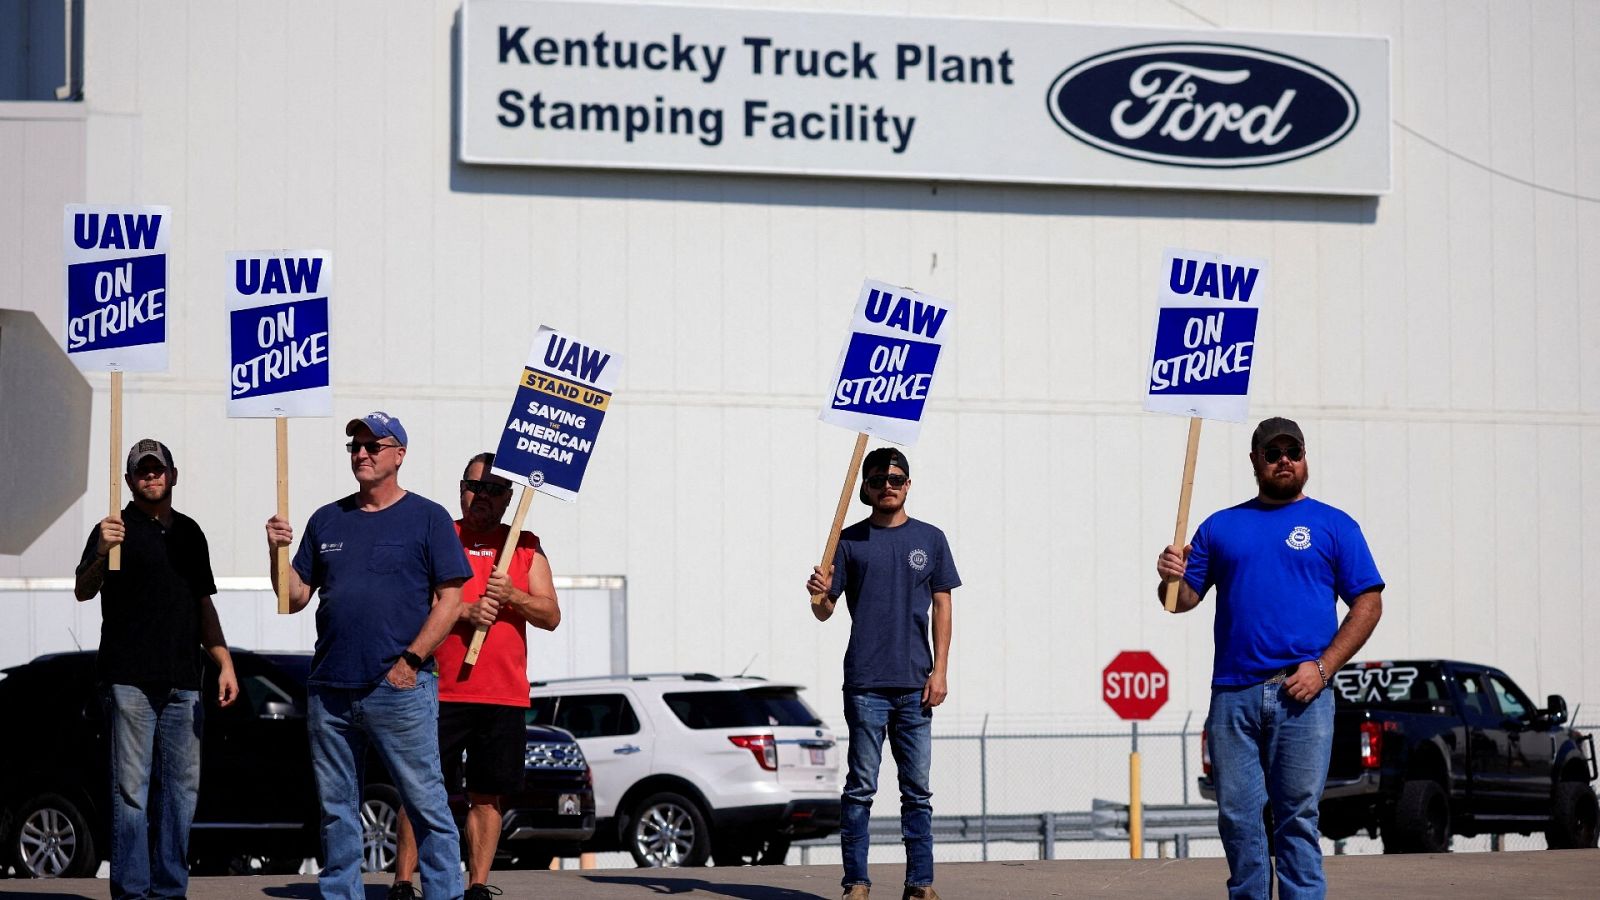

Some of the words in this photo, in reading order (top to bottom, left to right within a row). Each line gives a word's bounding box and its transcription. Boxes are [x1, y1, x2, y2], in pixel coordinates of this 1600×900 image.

[497, 25, 726, 84] Kentucky
[743, 36, 878, 79] Truck
[896, 43, 1015, 85] Plant
[497, 88, 724, 147] Stamping
[743, 99, 916, 154] Facility
[1109, 61, 1297, 146] Ford
[73, 213, 162, 250] UAW
[94, 262, 133, 303] ON
[235, 257, 323, 296] UAW
[1169, 257, 1260, 303] UAW
[68, 288, 165, 349] STRIKE
[257, 306, 295, 349] ON
[864, 288, 948, 339] UAW
[1183, 311, 1225, 349] ON
[232, 331, 328, 396] STRIKE
[543, 333, 611, 384] UAW
[869, 343, 911, 374] ON
[1151, 341, 1254, 391] STRIKE
[525, 373, 580, 400] STAND
[582, 390, 604, 407] UP
[834, 373, 932, 406] STRIKE
[508, 417, 592, 453] AMERICAN
[526, 401, 587, 430] SAVING
[549, 422, 561, 430] THE
[516, 436, 574, 465] DREAM
[1105, 671, 1166, 700] STOP
